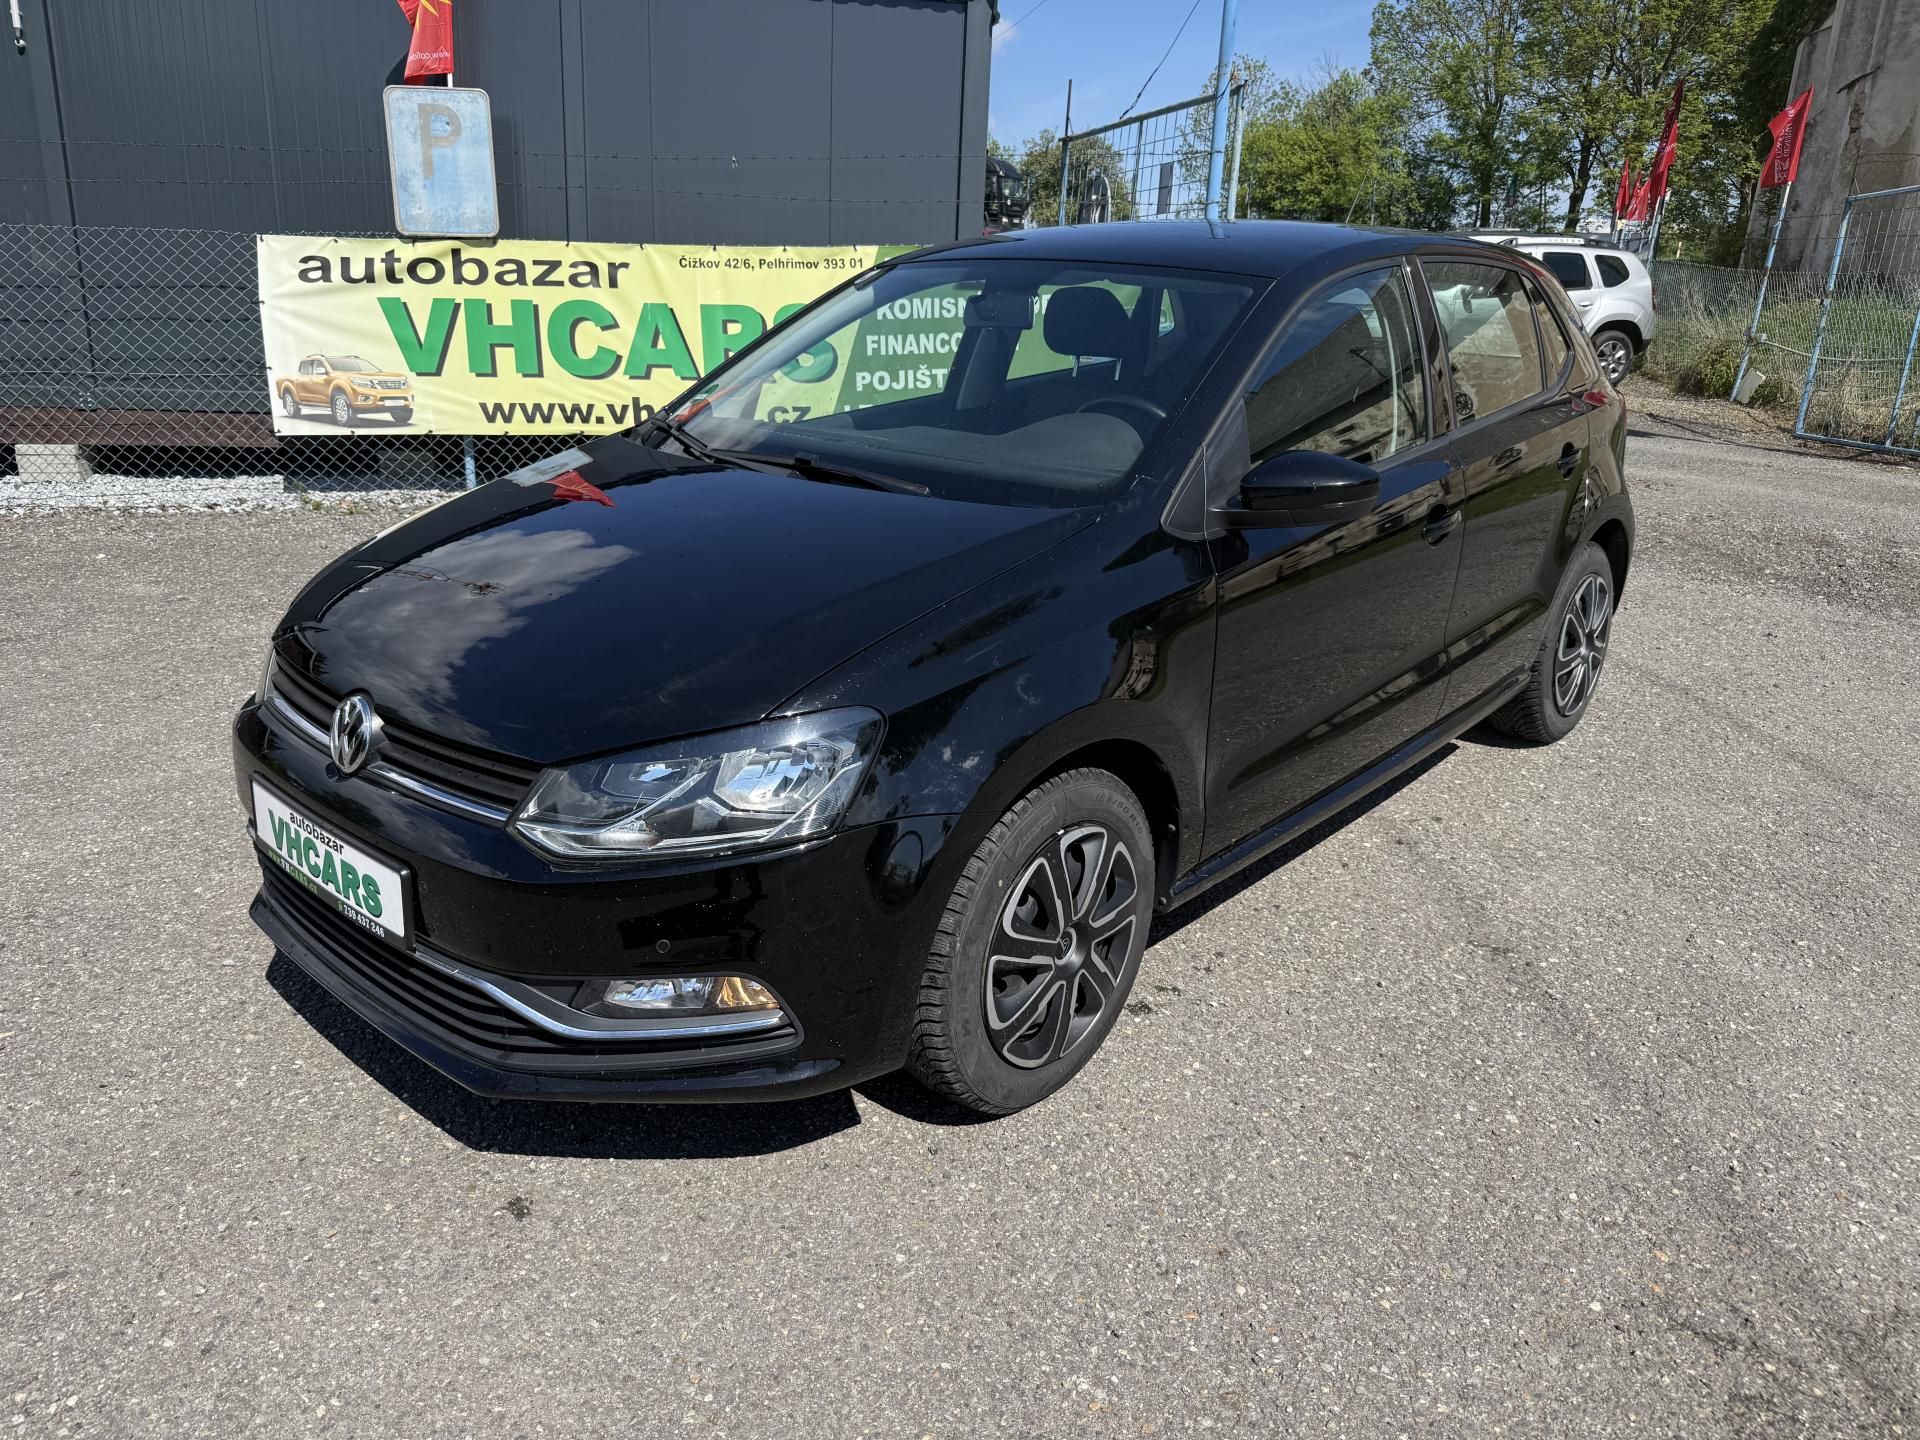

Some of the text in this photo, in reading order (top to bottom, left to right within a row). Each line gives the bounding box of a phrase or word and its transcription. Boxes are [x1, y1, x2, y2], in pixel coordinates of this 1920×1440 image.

[418, 103, 462, 177] P
[298, 248, 630, 288] autobazar
[679, 255, 863, 272] Čížkov 42/6, Pelhřimov 393 01
[377, 297, 838, 383] VHCARS
[290, 812, 344, 855] autobazar
[268, 808, 383, 918] VHCARS
